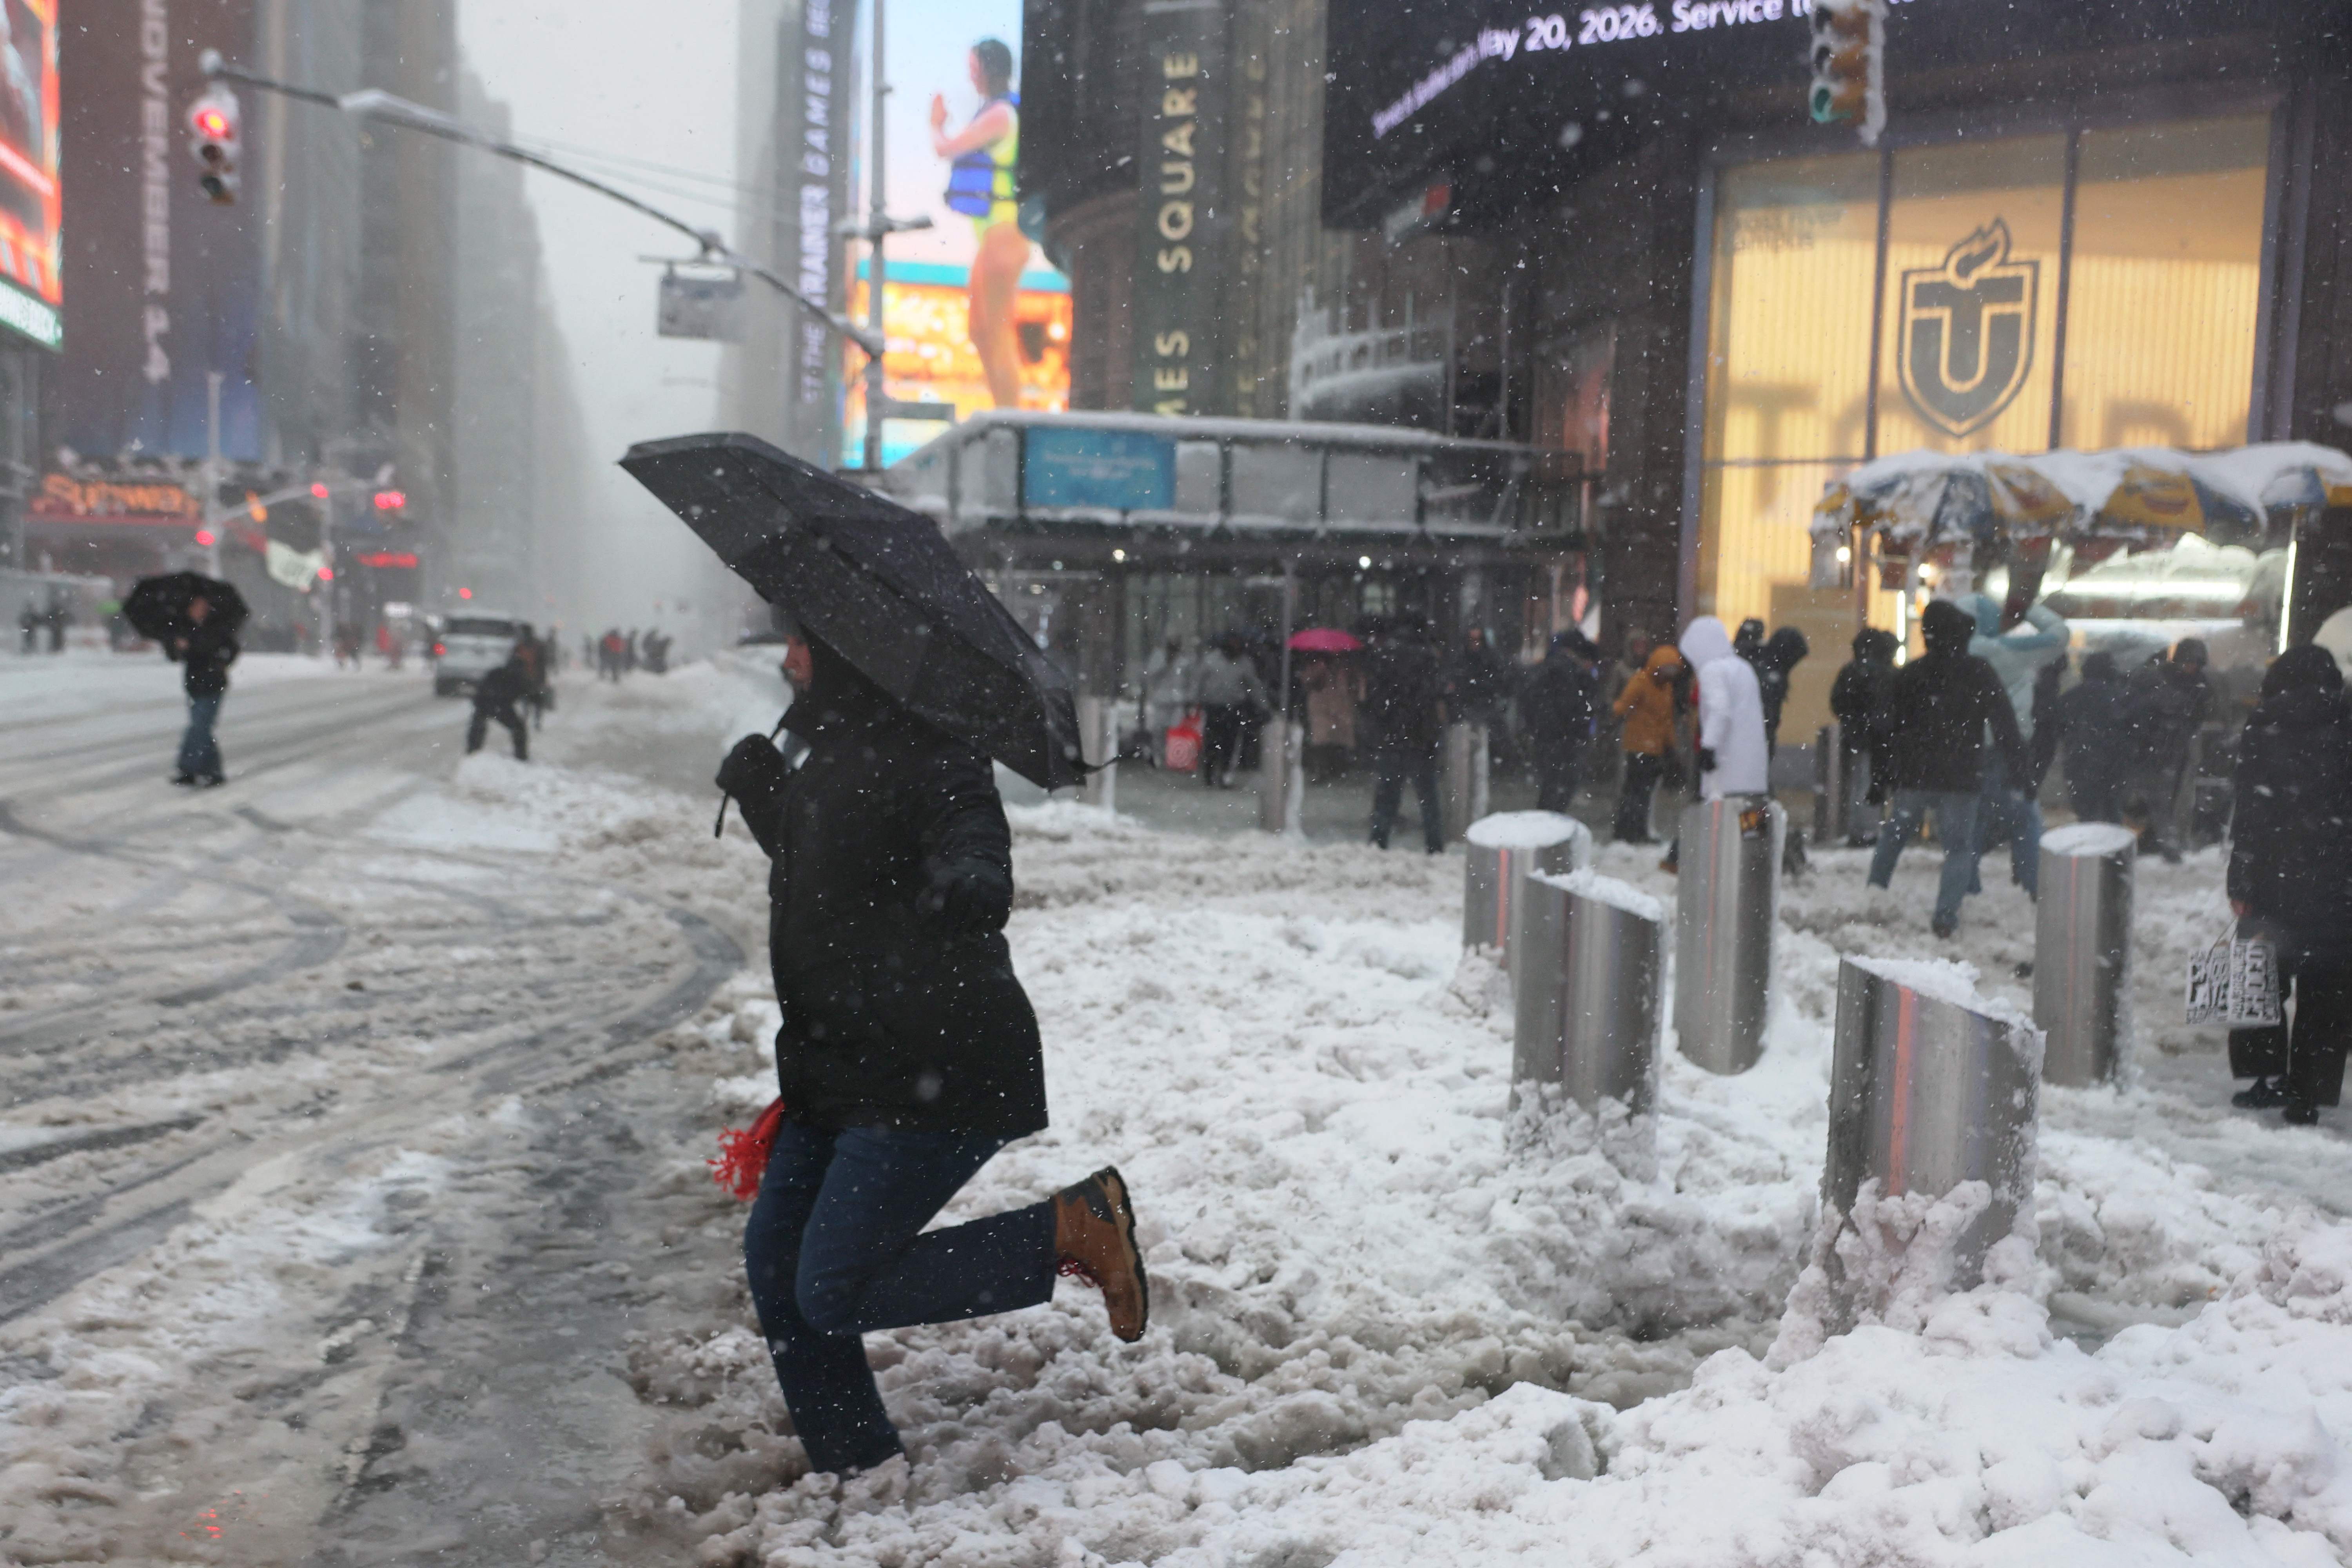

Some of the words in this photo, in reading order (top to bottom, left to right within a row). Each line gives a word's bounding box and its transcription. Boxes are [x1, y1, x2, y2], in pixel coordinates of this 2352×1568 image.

[1524, 14, 1572, 51] 20,
[1578, 3, 1664, 45] 2026.
[1671, 0, 1783, 33] Service
[804, 47, 832, 176] GAMES
[1158, 52, 1198, 273] SQUARE
